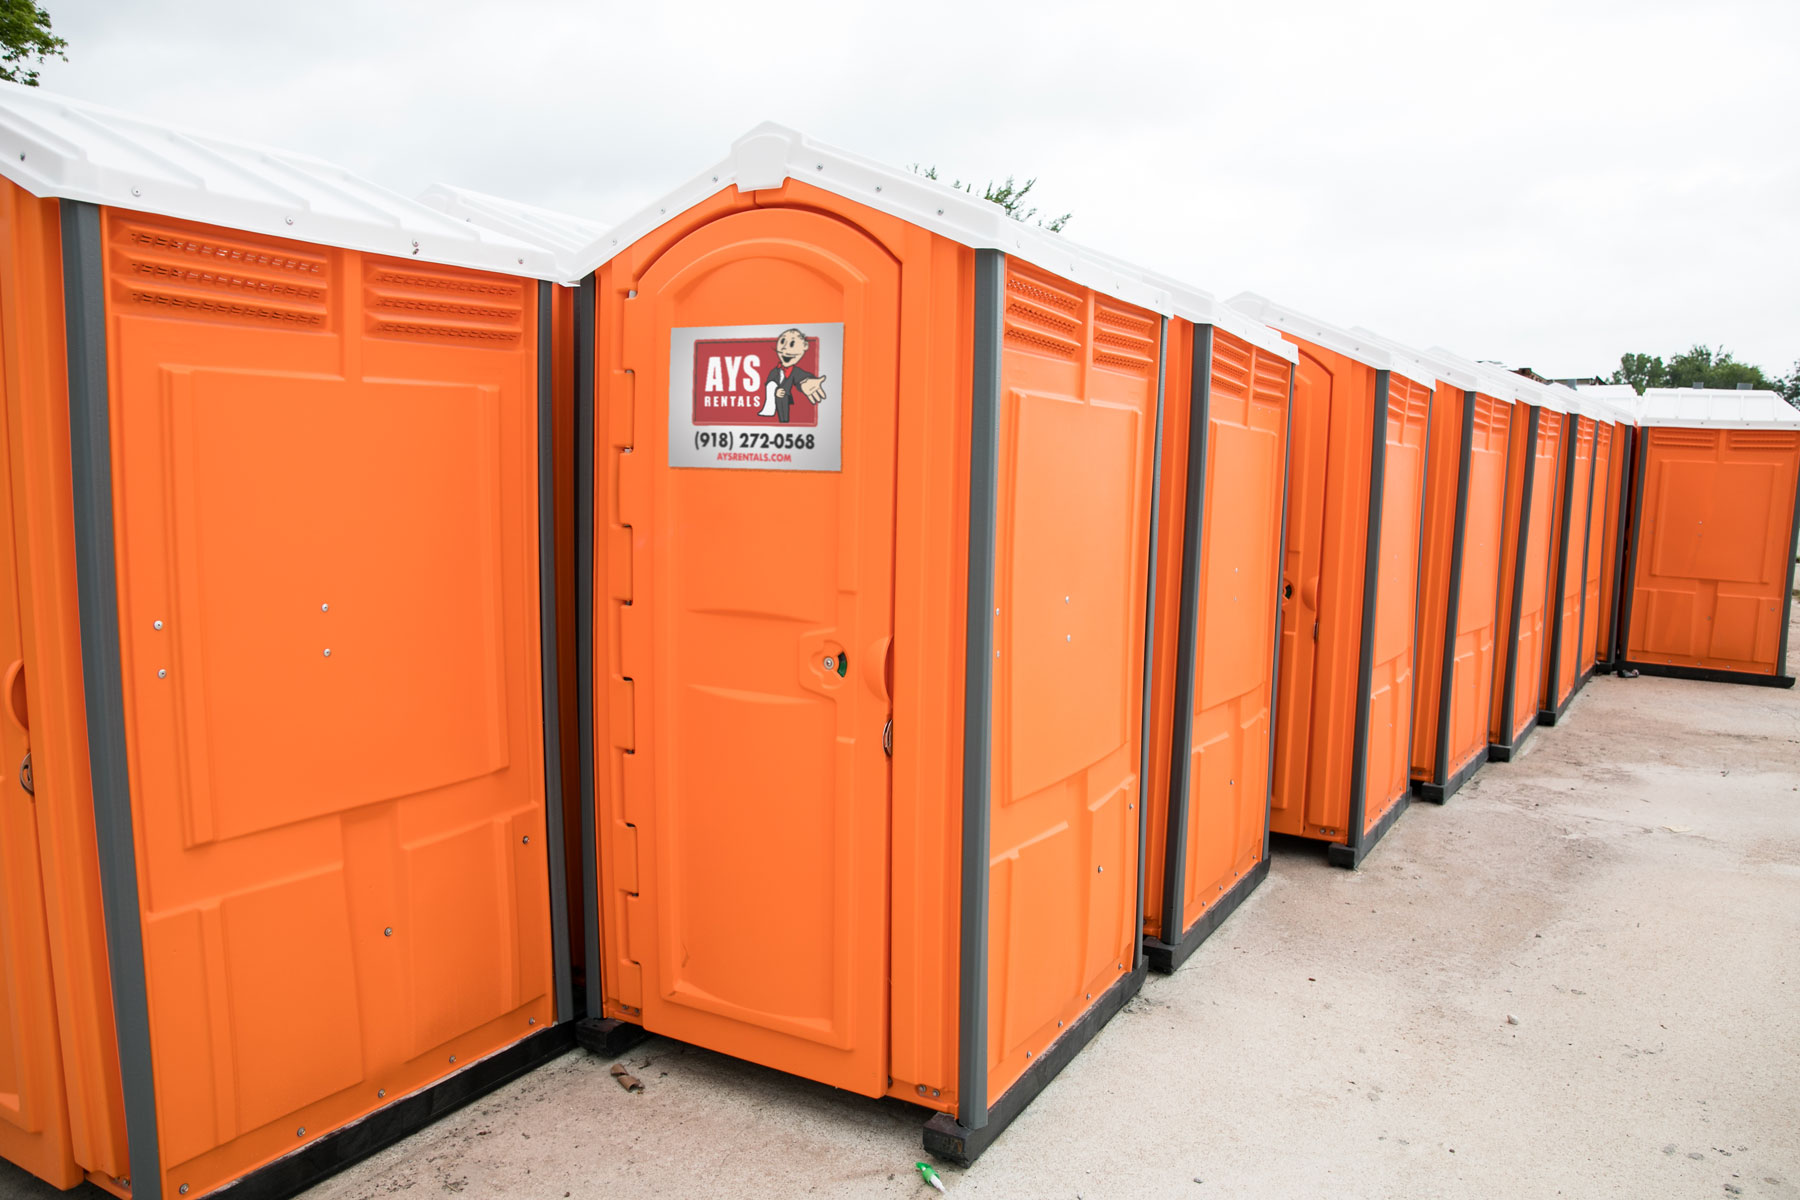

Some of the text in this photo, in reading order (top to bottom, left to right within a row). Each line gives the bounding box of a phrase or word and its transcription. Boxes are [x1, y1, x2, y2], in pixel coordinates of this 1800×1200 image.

[704, 354, 761, 392] AYS
[704, 395, 761, 408] RENTALS
[694, 431, 815, 451] (918) 272-0568
[716, 452, 792, 463] AYSRENTALS.COM
